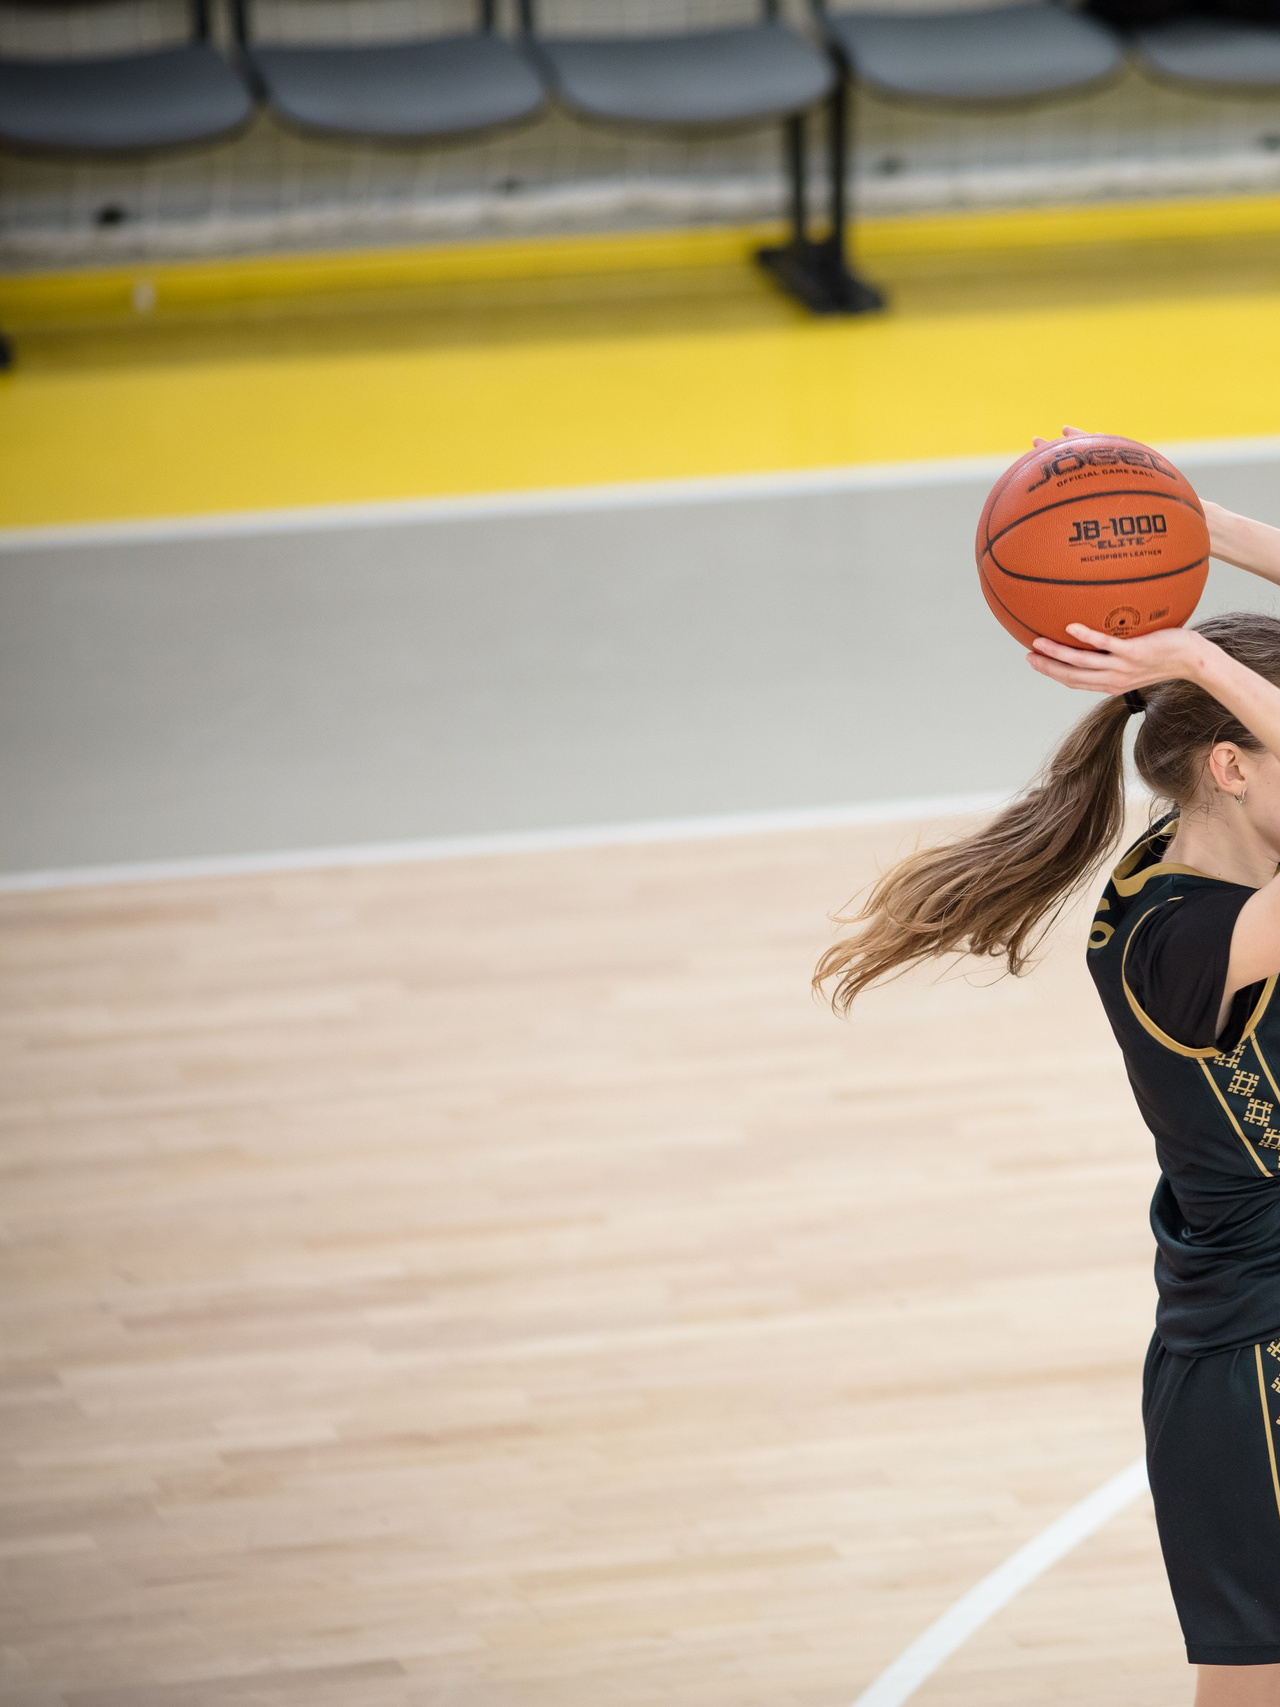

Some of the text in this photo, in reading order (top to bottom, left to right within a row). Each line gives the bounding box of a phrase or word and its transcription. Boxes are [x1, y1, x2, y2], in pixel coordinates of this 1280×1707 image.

[1027, 447, 1178, 493] JÖGEL
[1056, 467, 1155, 488] OFFICIAL GAME BALL
[1068, 514, 1167, 542] JB-1000
[1097, 537, 1145, 550] ELITE
[1080, 549, 1162, 563] MICROFIBER LEATHER
